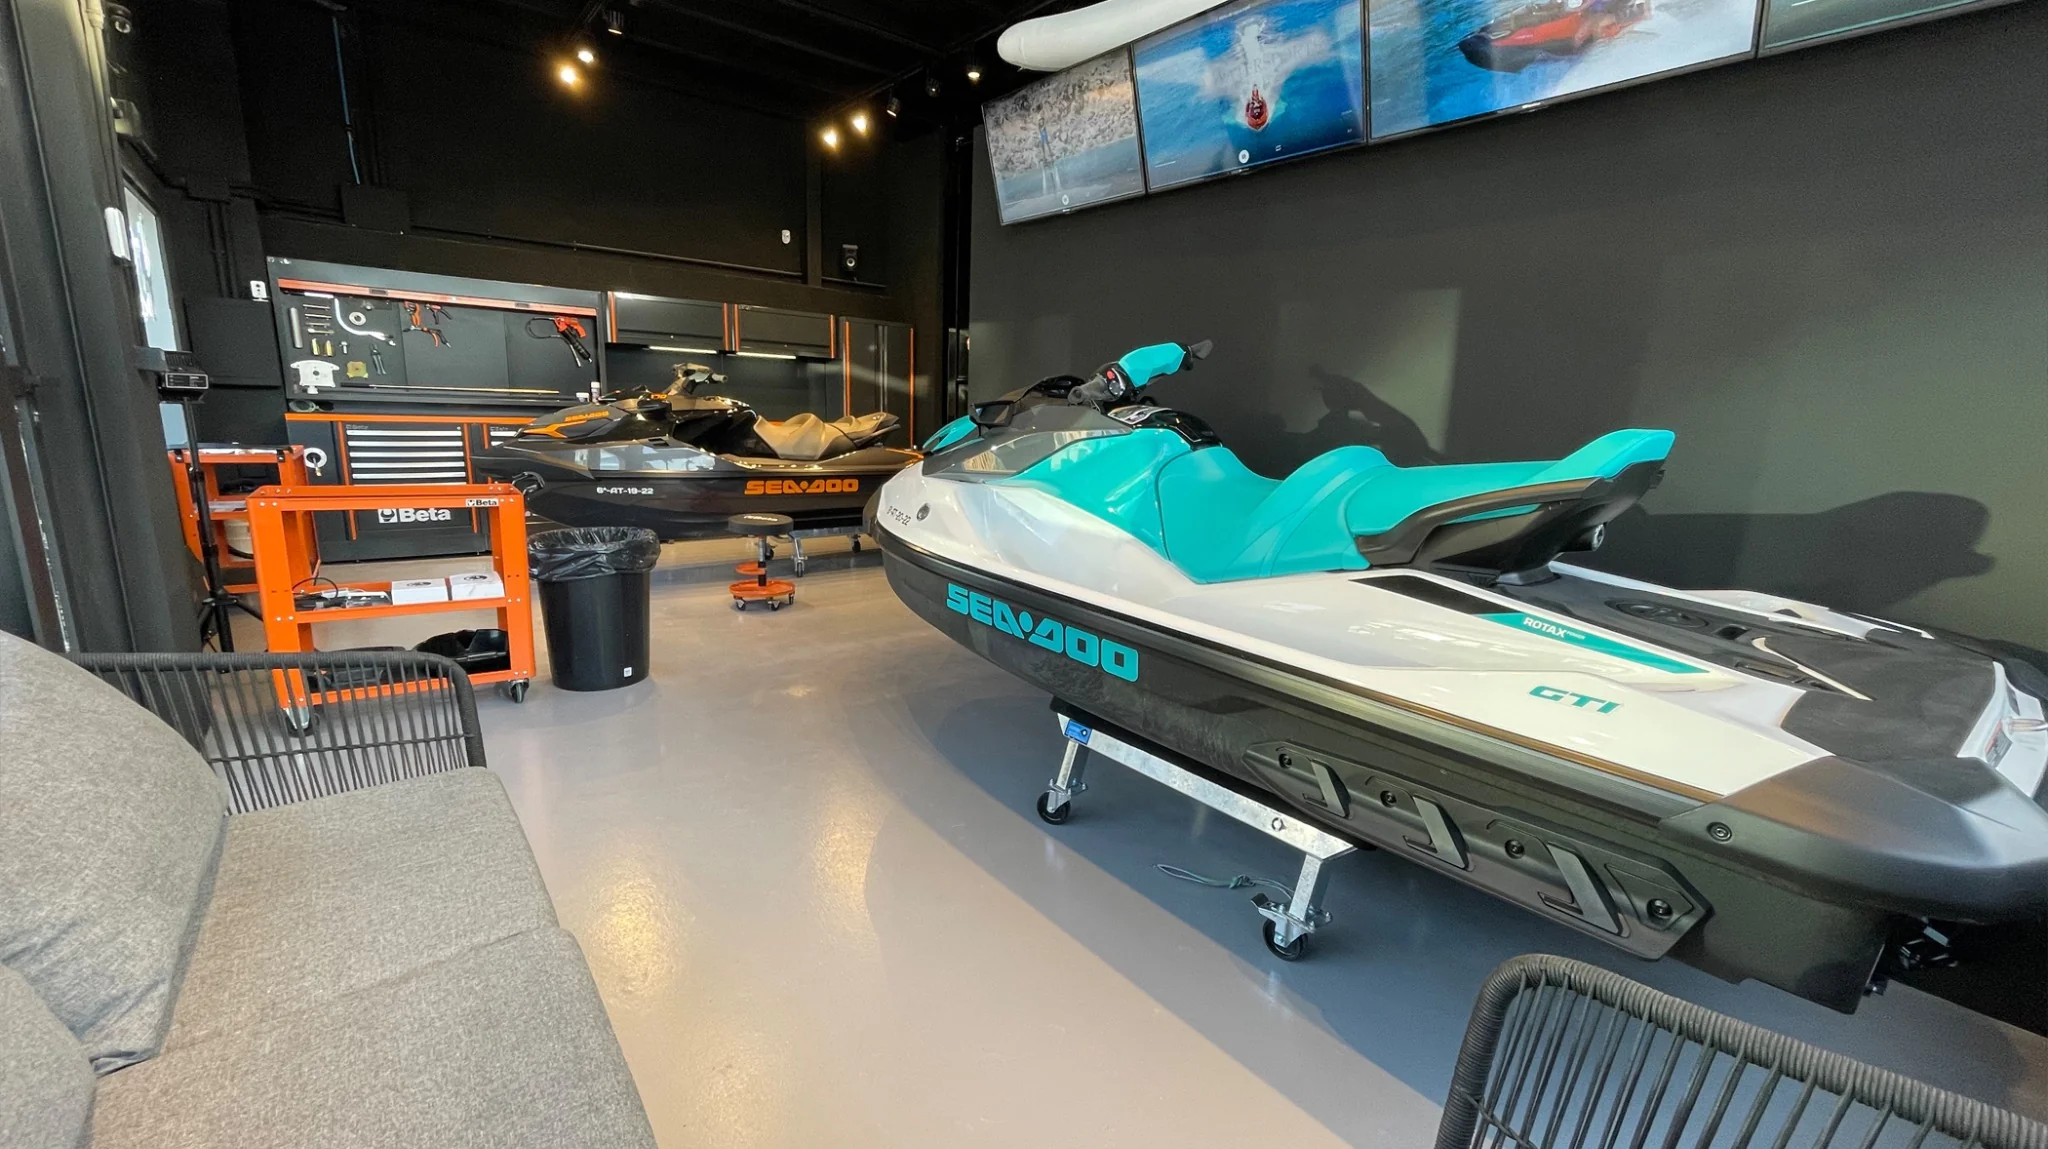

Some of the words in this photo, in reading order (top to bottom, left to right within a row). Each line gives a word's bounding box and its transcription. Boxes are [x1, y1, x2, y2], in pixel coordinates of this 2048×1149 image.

[475, 499, 498, 507] Beta
[399, 508, 451, 523] Beta
[1523, 617, 1567, 638] ROTAX
[1529, 685, 1621, 714] GTI
